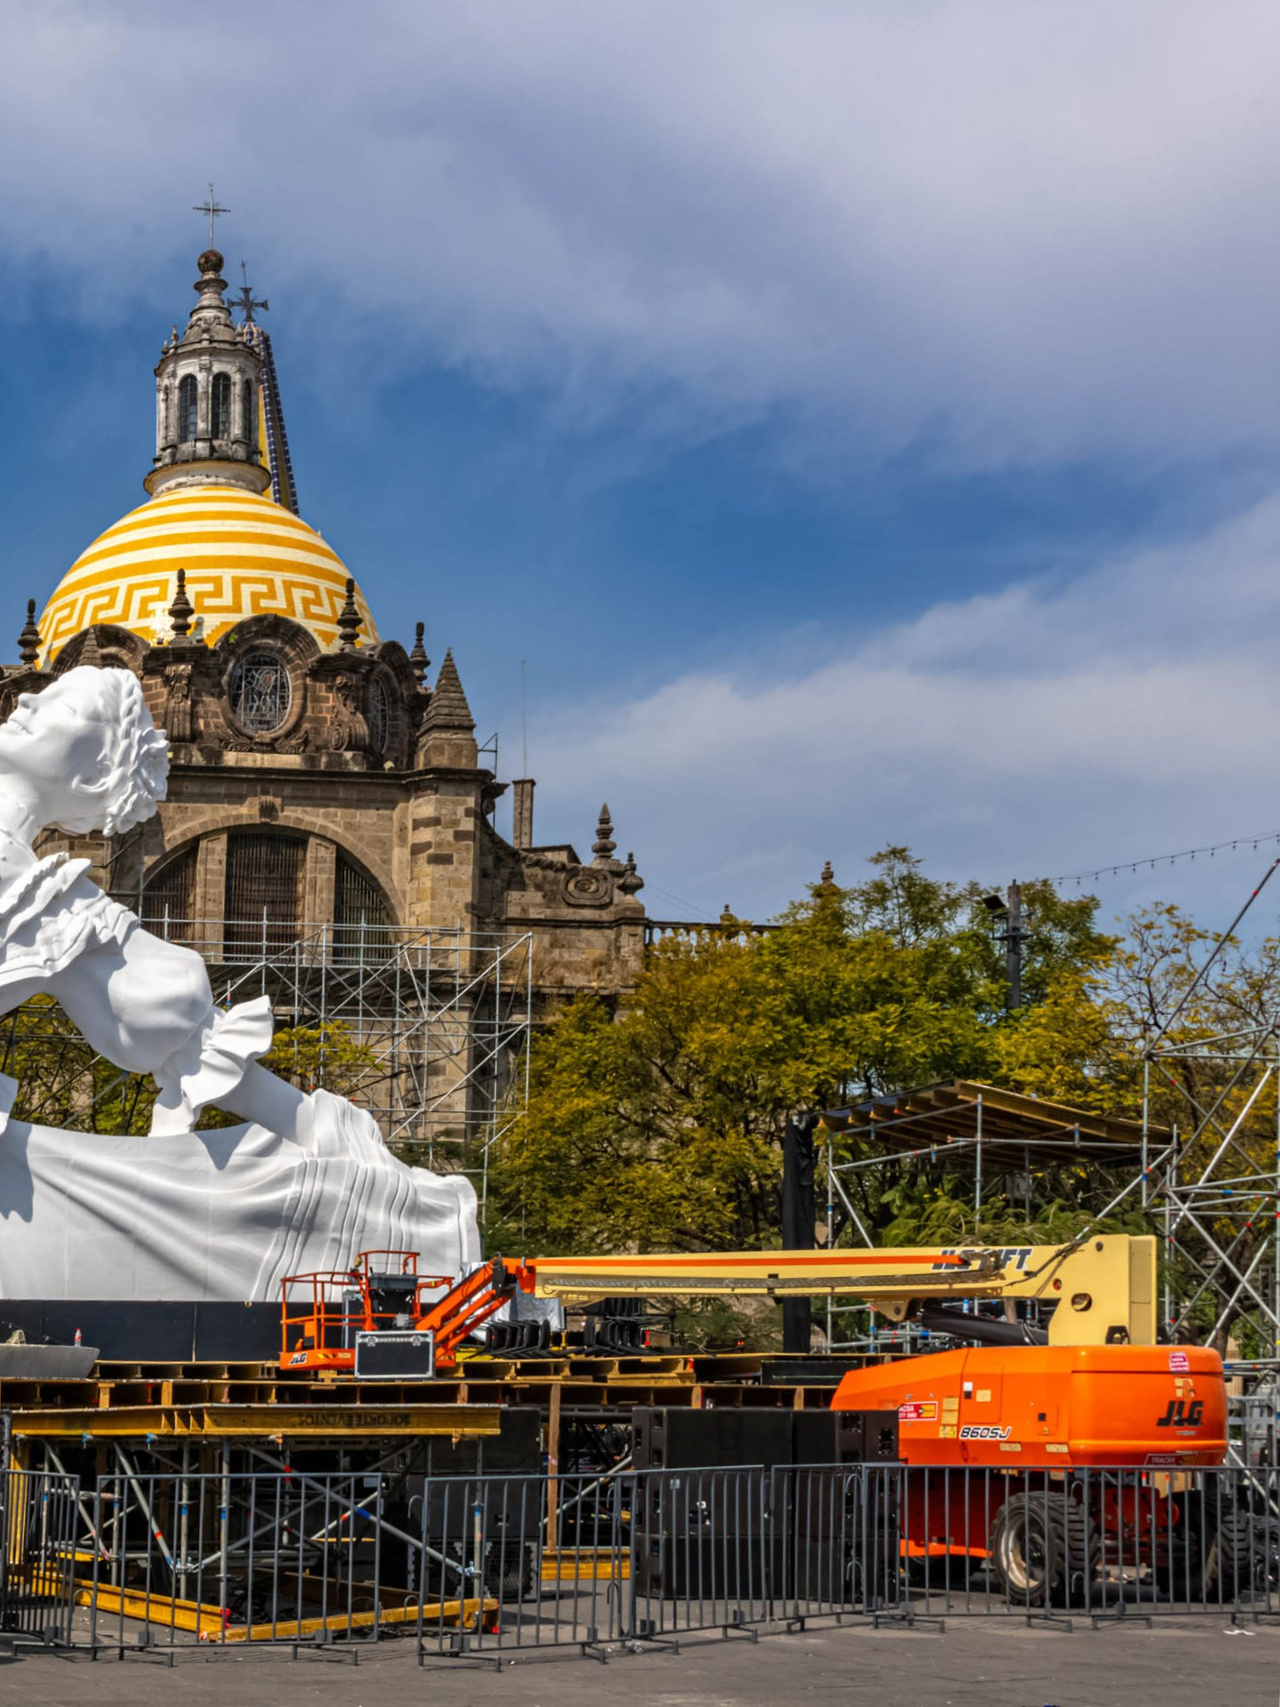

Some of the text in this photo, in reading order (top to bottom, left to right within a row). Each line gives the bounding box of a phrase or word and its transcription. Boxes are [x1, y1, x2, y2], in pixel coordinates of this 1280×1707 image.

[289, 1352, 307, 1365] JLG
[1157, 1400, 1204, 1427] JLG
[959, 1426, 1011, 1440] 860SJ
